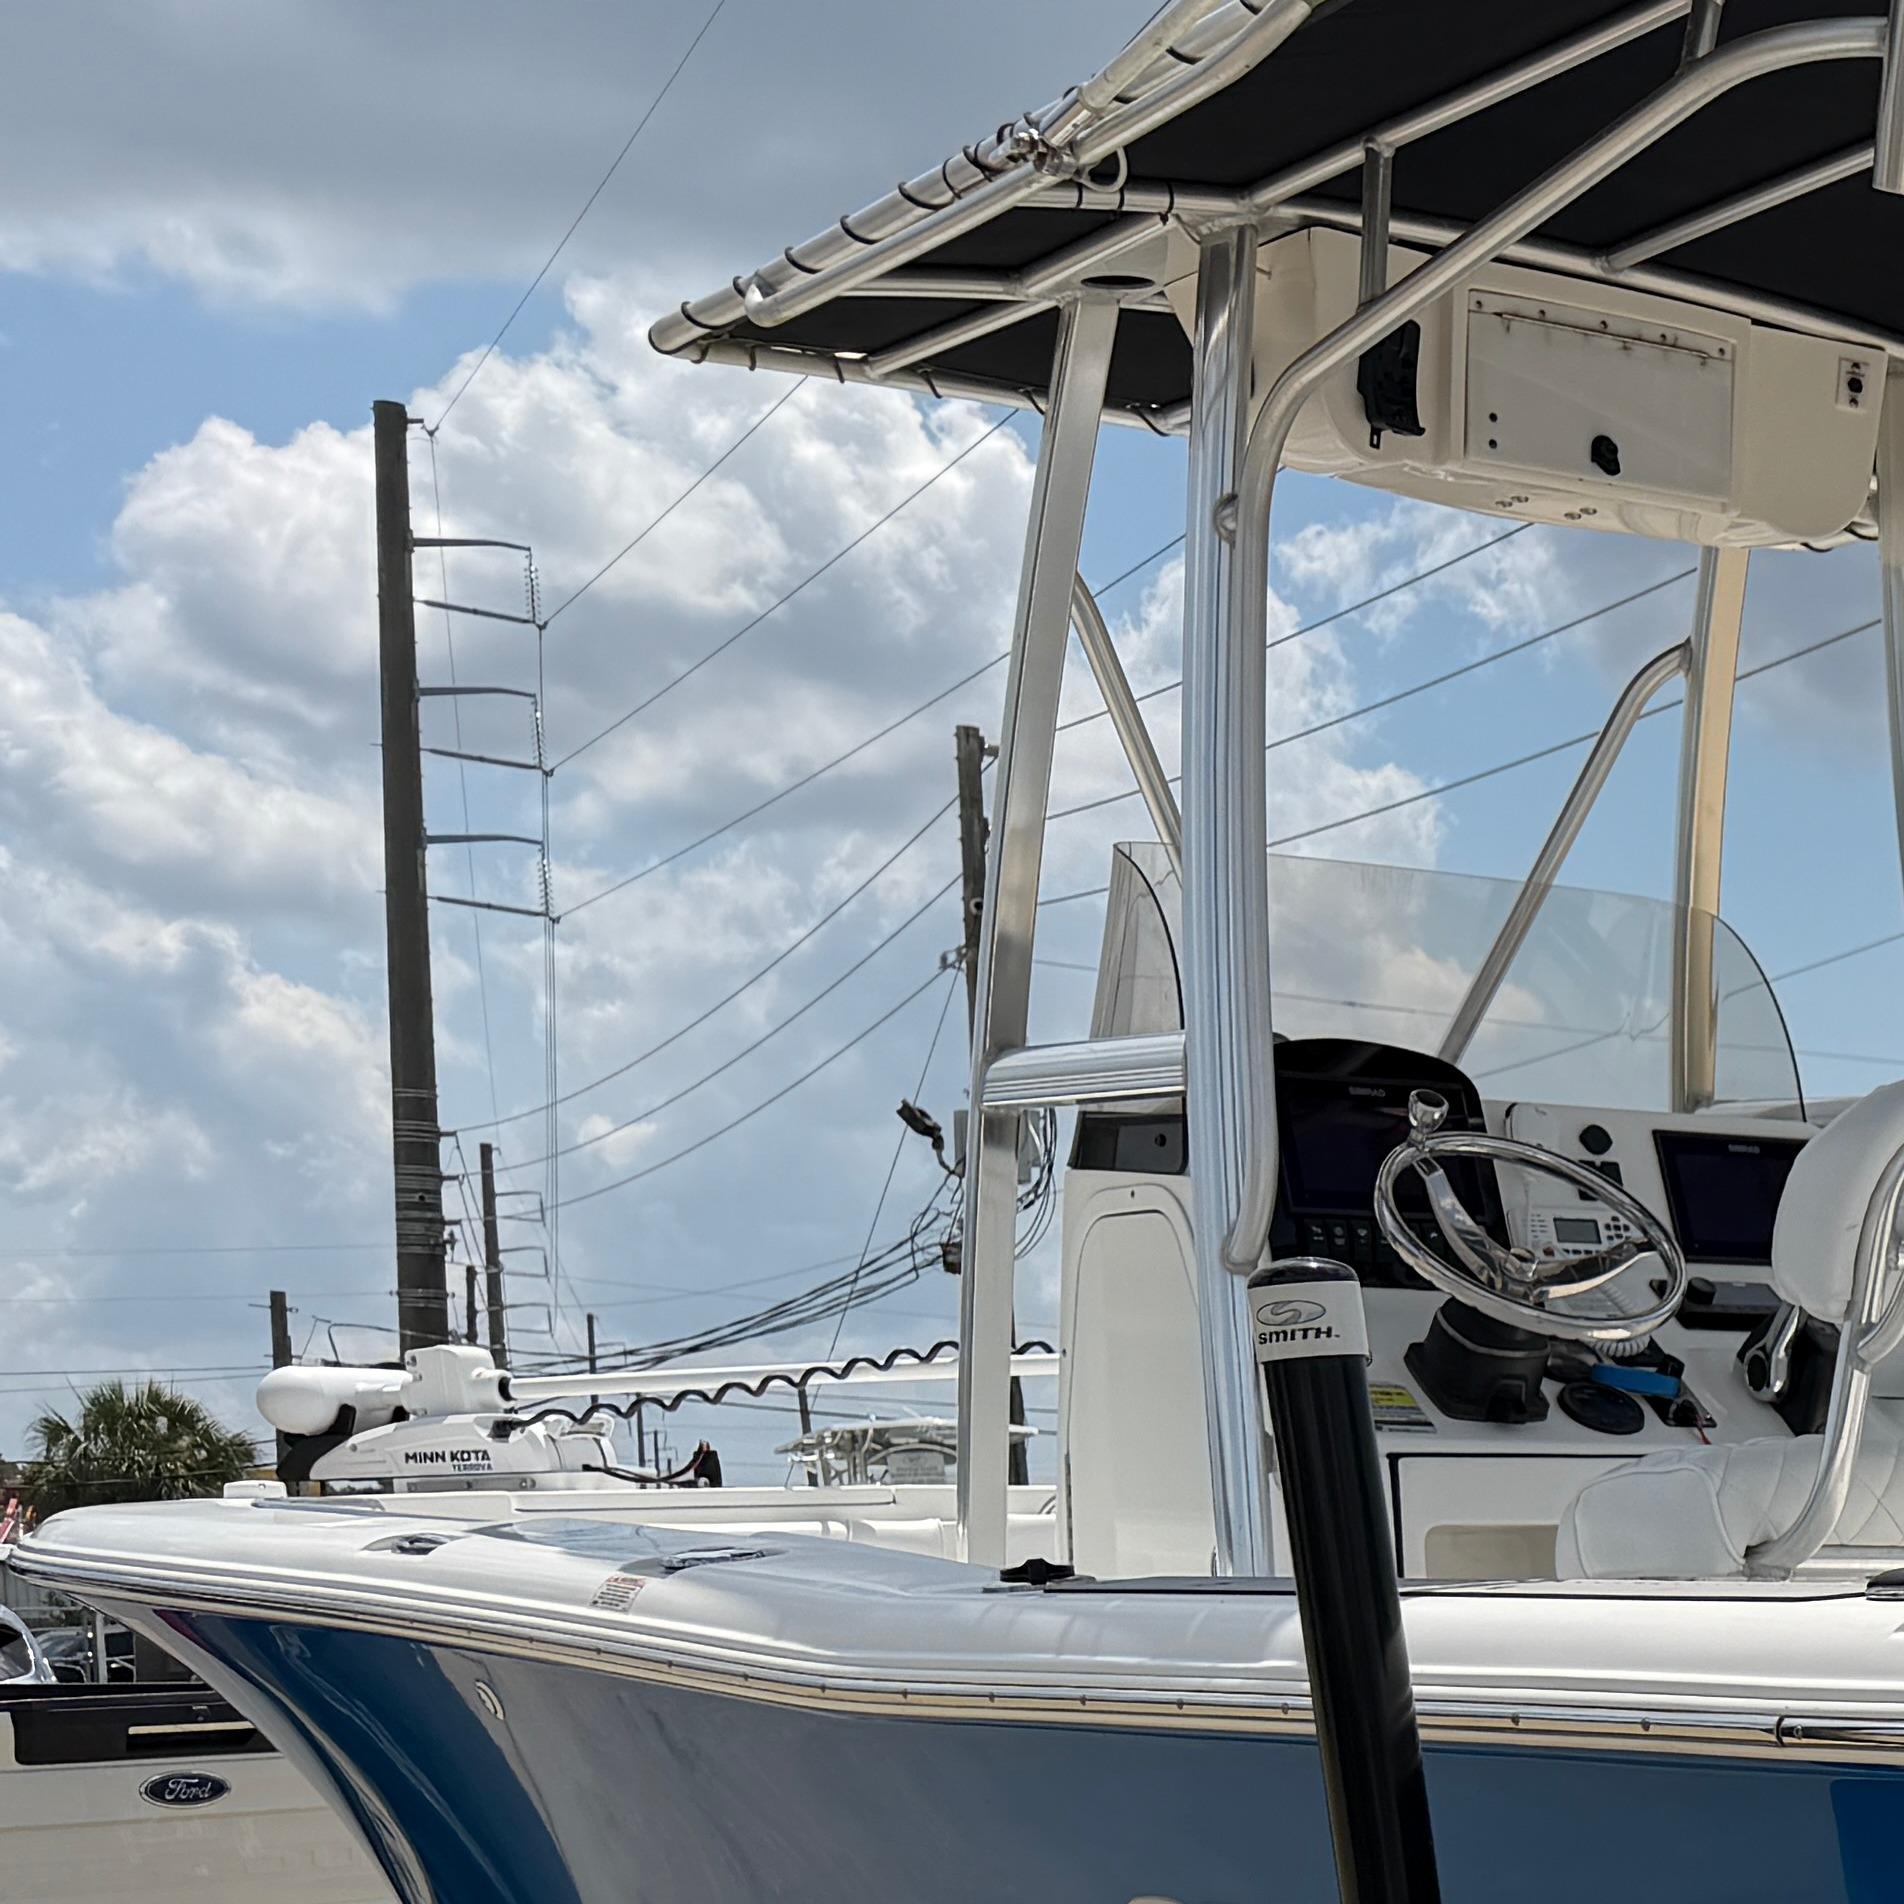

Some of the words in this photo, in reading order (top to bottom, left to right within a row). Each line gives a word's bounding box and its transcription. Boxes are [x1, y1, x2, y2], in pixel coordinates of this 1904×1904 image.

[1258, 1326, 1333, 1345] SMITH
[404, 1450, 446, 1464] MINN
[450, 1449, 491, 1462] KOTA
[164, 1778, 212, 1800] Ford
